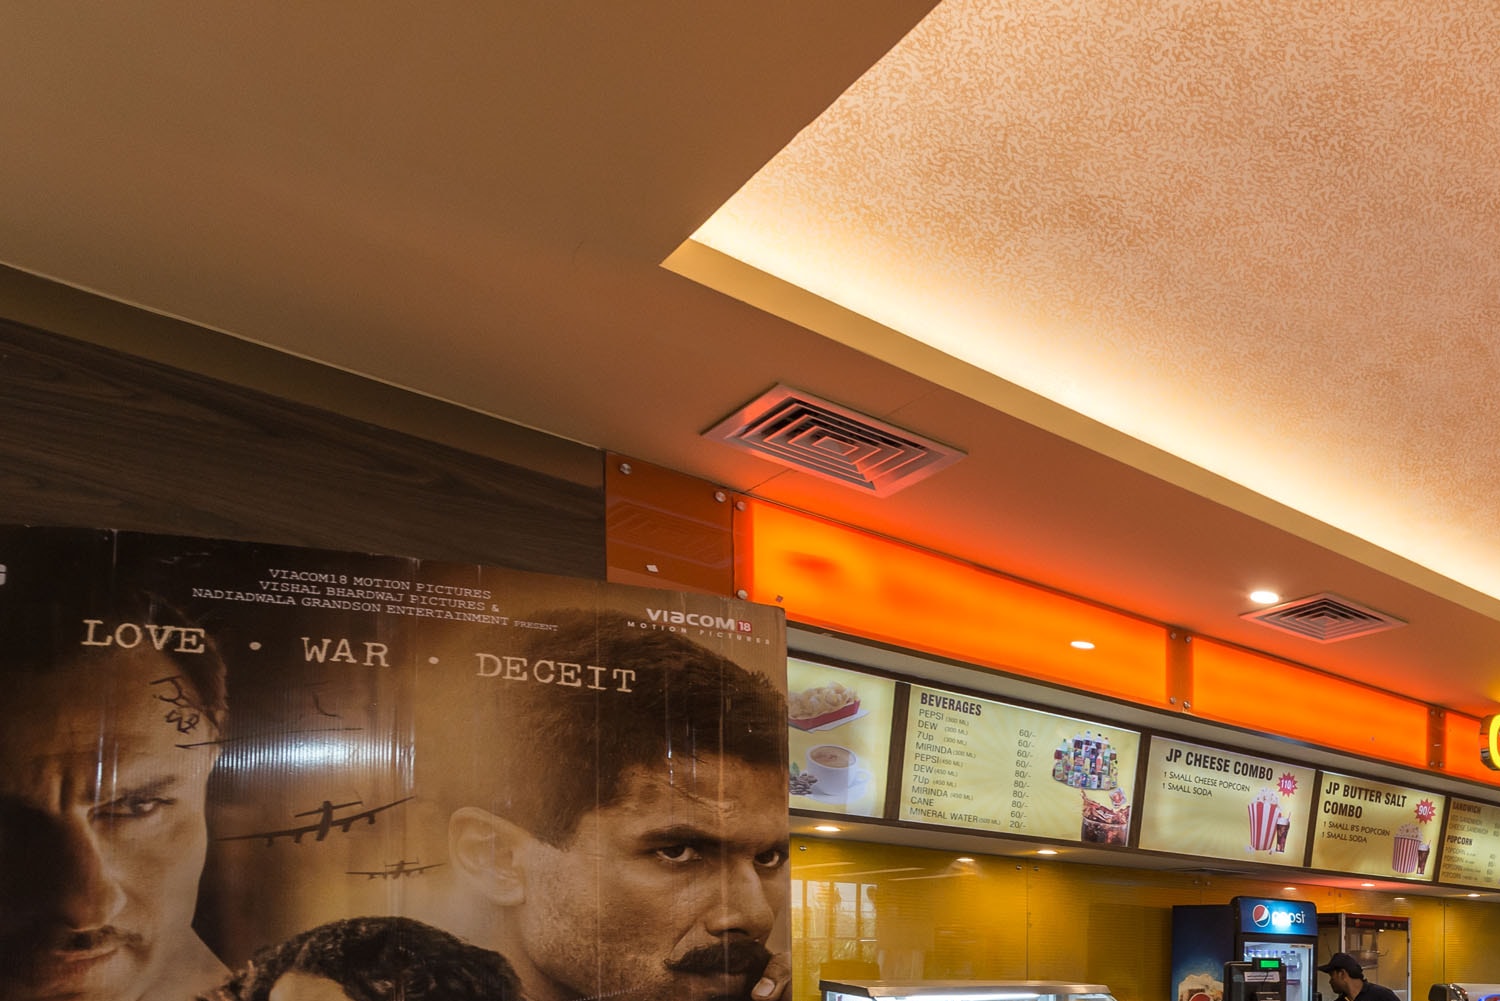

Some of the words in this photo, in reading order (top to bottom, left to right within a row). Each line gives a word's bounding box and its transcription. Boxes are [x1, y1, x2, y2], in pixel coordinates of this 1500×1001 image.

[269, 568, 348, 585] VIACOM18
[353, 576, 411, 591] MOTION
[416, 583, 492, 600] PICTURES
[259, 580, 321, 595] VISHAL
[326, 587, 404, 602] BHARDWAJ
[410, 594, 485, 612] PICTURES
[491, 604, 500, 613] &
[192, 588, 296, 606] NADIADWALA
[301, 598, 382, 613] GRANDSON
[386, 604, 509, 626] ENTERTAINMENT
[514, 620, 559, 632] PRESENT
[627, 621, 687, 634] MOTION
[739, 621, 752, 632] 18
[81, 619, 205, 654] LOVE
[301, 637, 391, 667] WAR
[476, 653, 636, 693] DECEIT
[921, 692, 982, 717] BEVERAGES
[918, 720, 938, 731] DEW
[1018, 740, 1035, 748] 60/-
[919, 709, 944, 721] PEPSI
[1019, 729, 1037, 738] 60/-
[916, 742, 952, 755] MIRINDA
[1016, 760, 1032, 768] 60/-
[917, 731, 934, 742] 7Up
[1017, 750, 1033, 758] 60/-
[914, 764, 934, 774] DEW
[1014, 780, 1030, 788] 80/-
[915, 753, 940, 764] PEPSI
[1015, 770, 1031, 778] 80/-
[1166, 748, 1182, 763] JP
[1186, 752, 1230, 773] CHEESE
[1233, 761, 1273, 781] COMBO
[913, 775, 929, 785] 7Up
[1013, 790, 1029, 799] 80/-
[1168, 783, 1191, 794] SMALL
[1193, 788, 1212, 797] SODA
[1169, 771, 1192, 782] SMALL
[1194, 775, 1218, 787] CHEESE
[1219, 780, 1251, 792] POPCORN
[912, 785, 948, 798] MIRINDA
[1011, 800, 1029, 809] 80/-
[1326, 781, 1340, 795] JP
[1343, 785, 1382, 803] BUTTER
[1384, 792, 1407, 807] SALT
[909, 807, 947, 820] MINERAL
[950, 812, 978, 823] WATER
[1009, 820, 1027, 829] 20/-
[910, 796, 935, 806] CANE
[1010, 810, 1028, 819] 60/-
[1323, 800, 1362, 819] COMBO
[1418, 805, 1432, 817] 90/-
[1327, 832, 1348, 841] SMALL
[1349, 834, 1367, 843] SODA
[1328, 821, 1349, 831] SMALL
[1361, 825, 1390, 836] POPCORN
[1446, 835, 1473, 846] POPCORN
